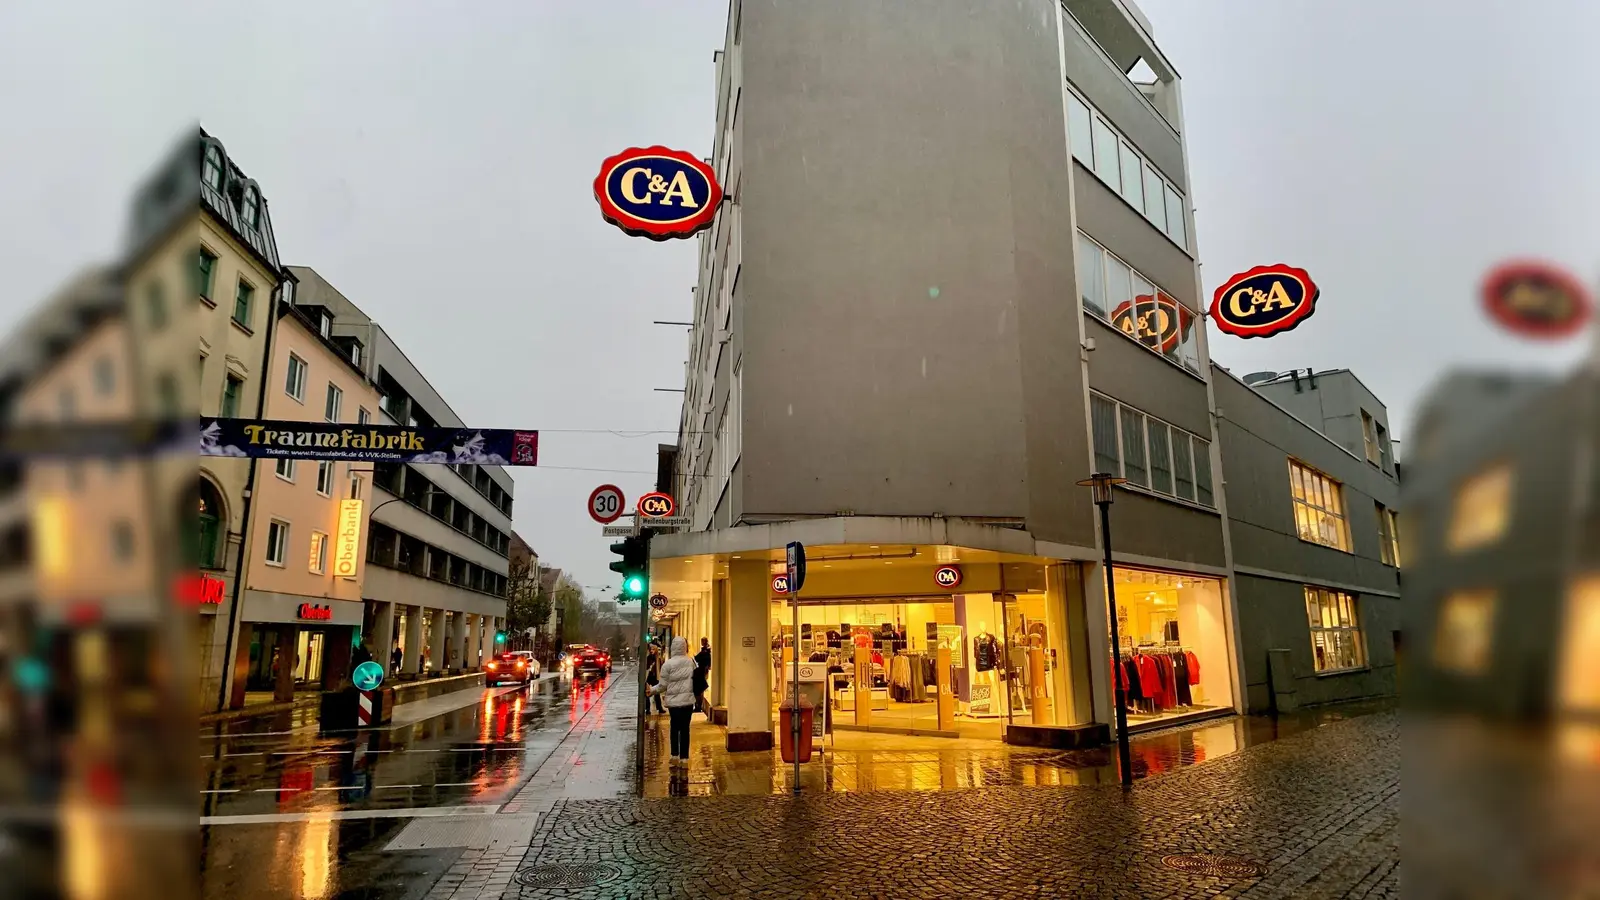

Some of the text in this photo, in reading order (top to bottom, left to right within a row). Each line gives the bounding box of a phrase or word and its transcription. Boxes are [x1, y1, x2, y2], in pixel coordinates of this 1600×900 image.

[621, 167, 699, 208] C&A
[1229, 280, 1295, 318] C&A
[244, 424, 425, 451] Traumfabrik
[291, 450, 357, 458] www.traumfabrik.de
[595, 495, 617, 512] 30
[644, 499, 668, 512] C&A
[642, 517, 690, 525] Weißenburgstraße
[339, 501, 359, 574] Oberbank
[604, 527, 632, 535] Postgasse
